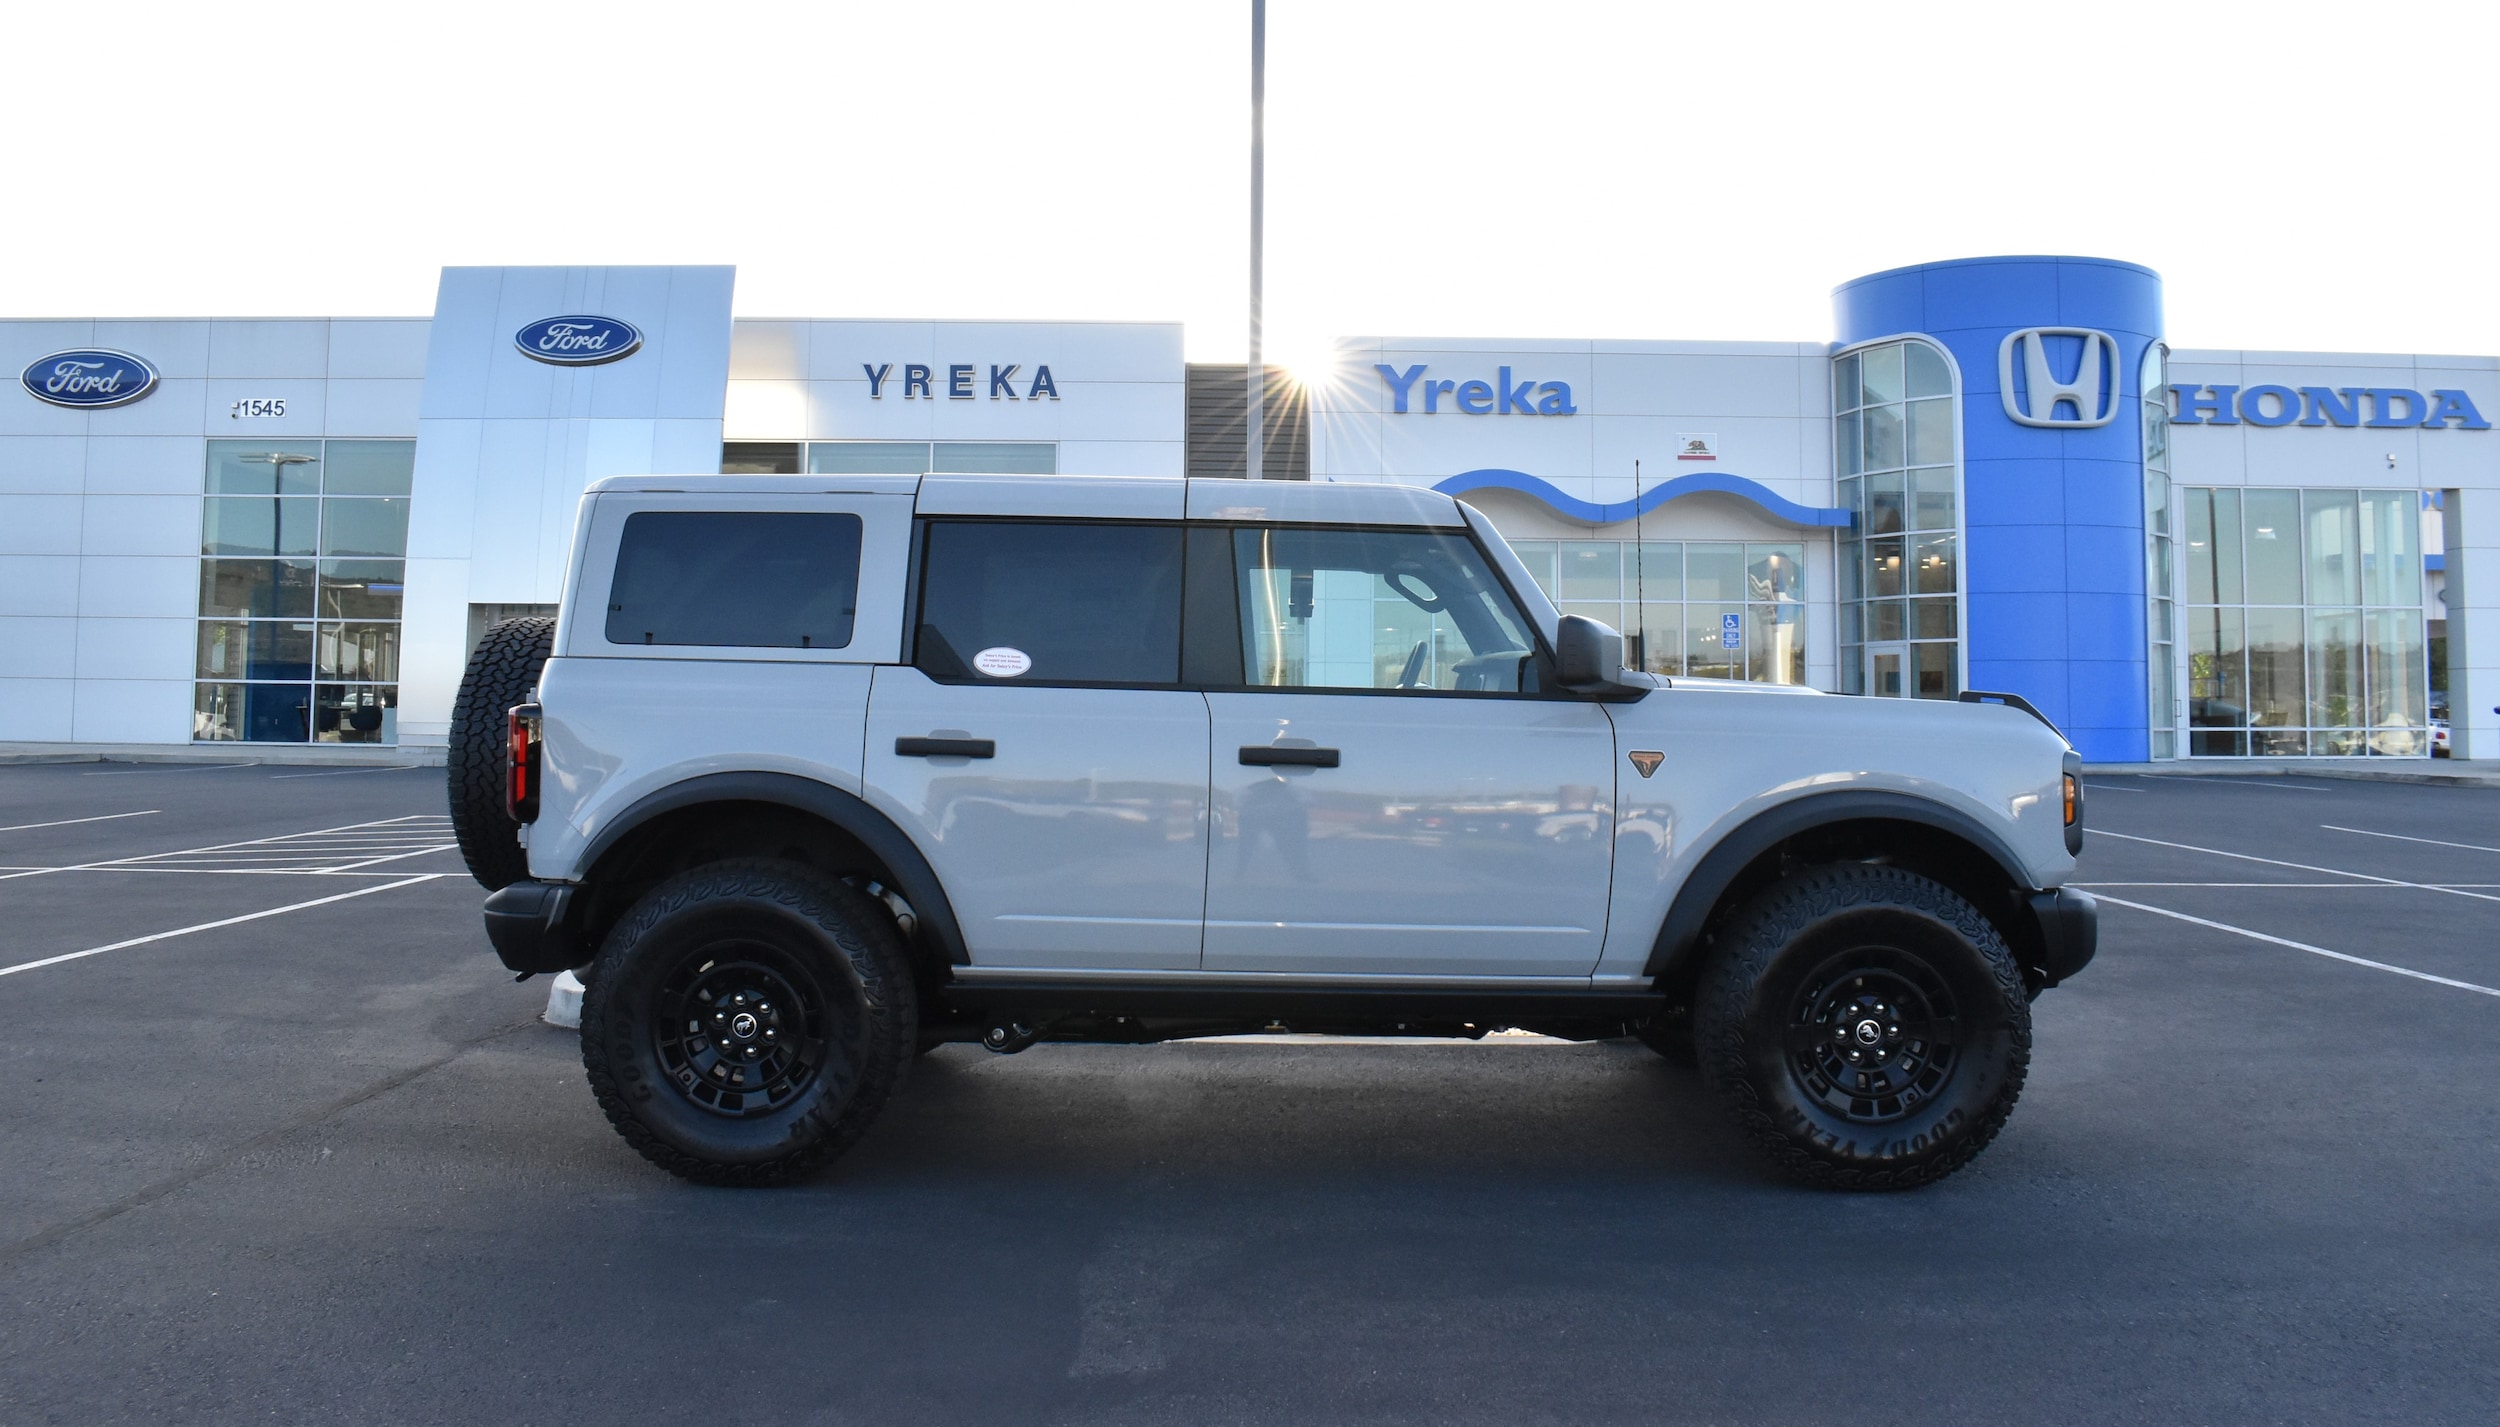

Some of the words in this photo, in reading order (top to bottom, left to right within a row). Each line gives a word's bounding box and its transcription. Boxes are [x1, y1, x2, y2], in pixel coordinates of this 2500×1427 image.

[540, 323, 611, 350] Ford
[46, 361, 124, 393] Ford
[862, 363, 1060, 400] YREKA
[1374, 364, 1577, 416] Yreka
[241, 399, 285, 417] 1545
[2168, 384, 2492, 429] HONDA
